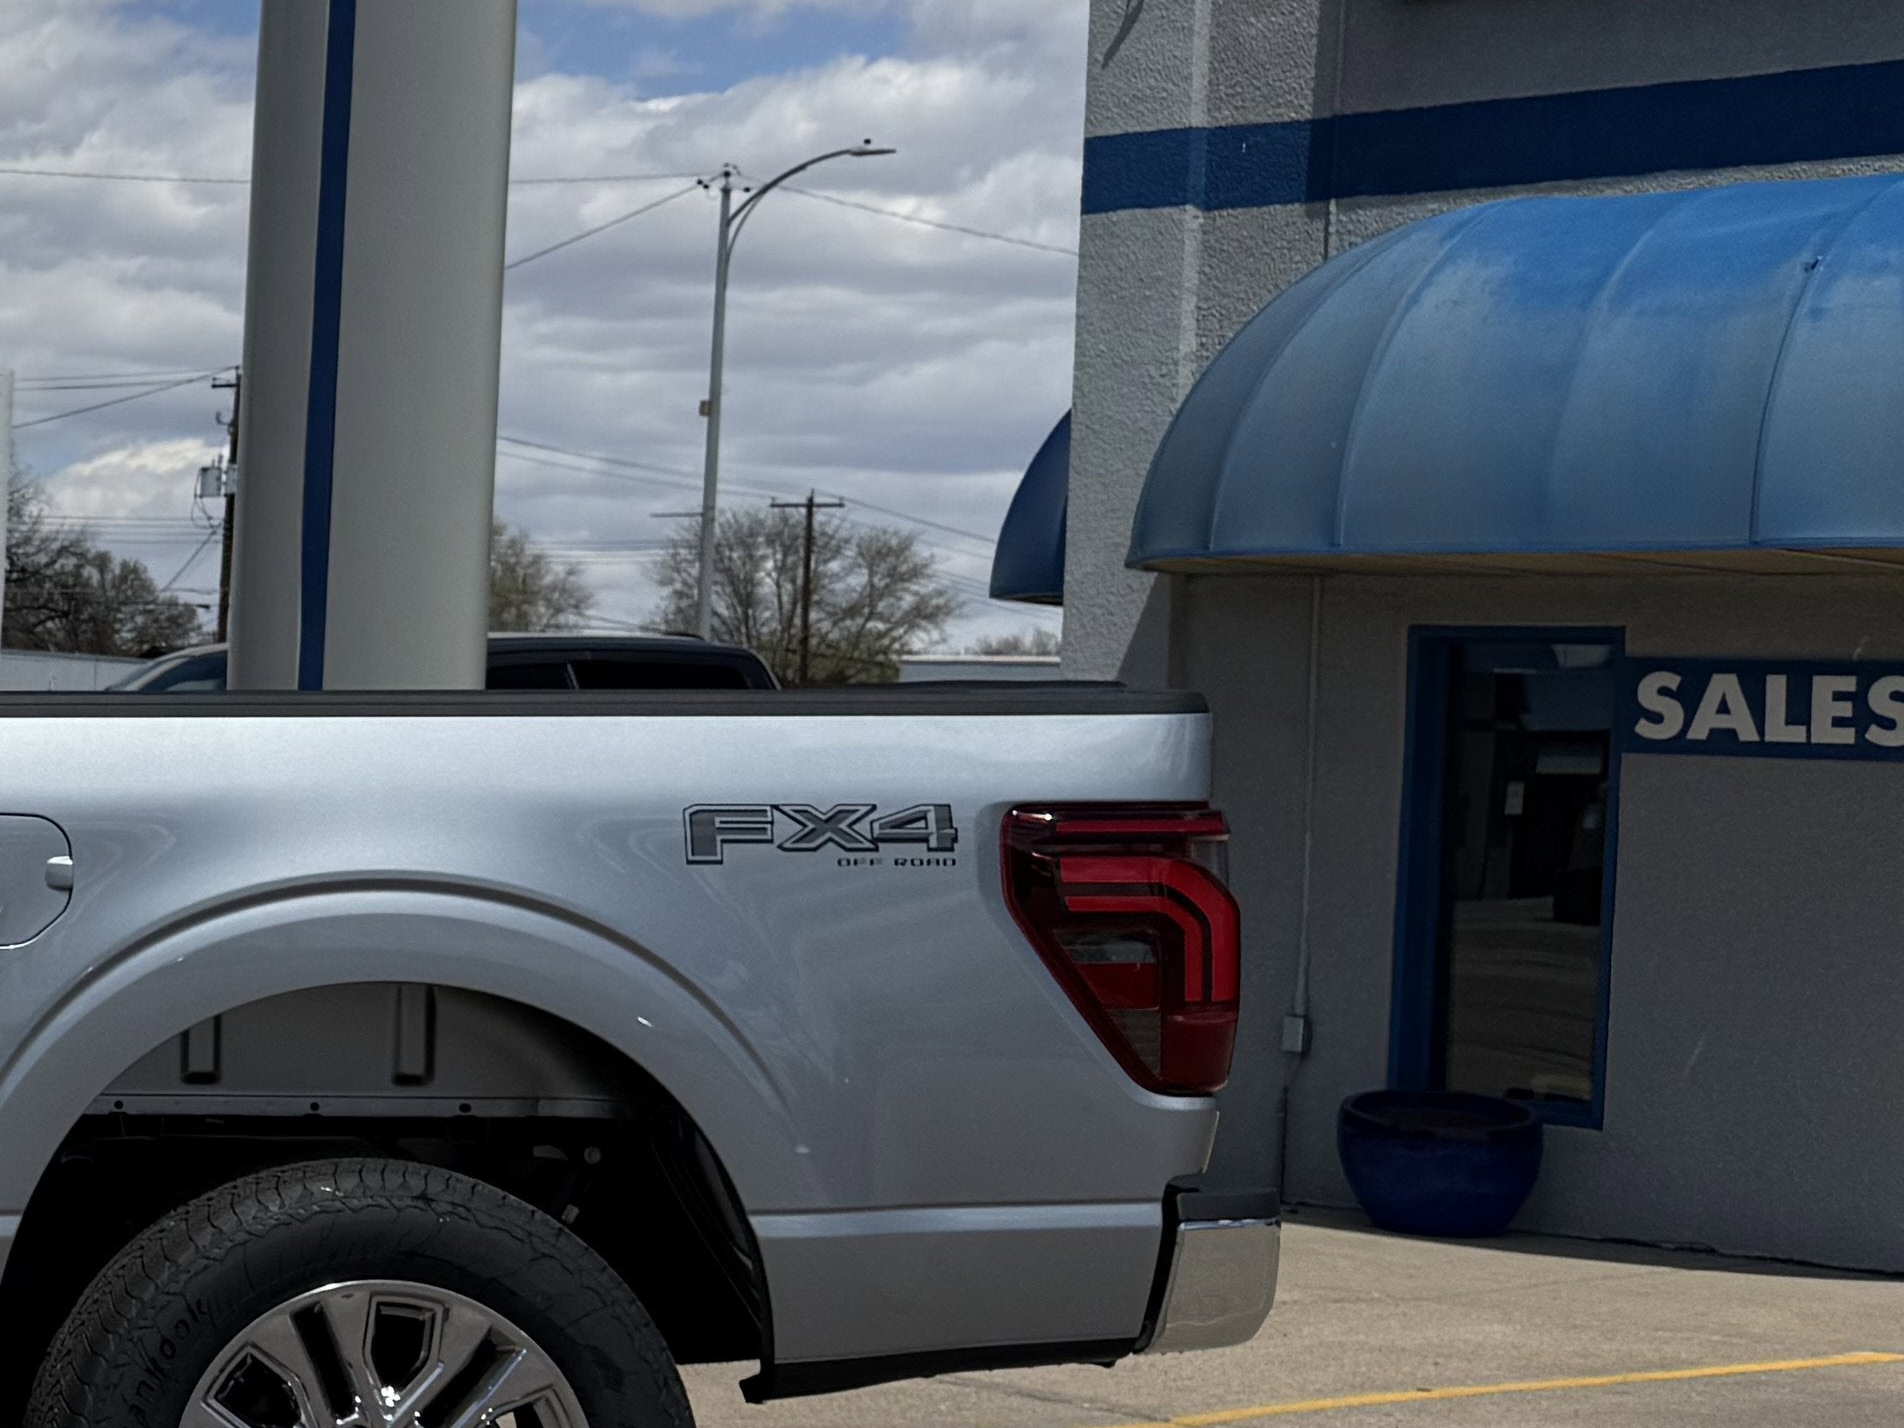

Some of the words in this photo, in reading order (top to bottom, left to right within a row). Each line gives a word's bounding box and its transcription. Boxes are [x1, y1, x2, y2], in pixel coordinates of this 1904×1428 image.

[1634, 671, 1904, 746] SALES
[683, 804, 958, 865] FX4
[837, 858, 883, 867] OFF
[894, 858, 956, 867] ROAD
